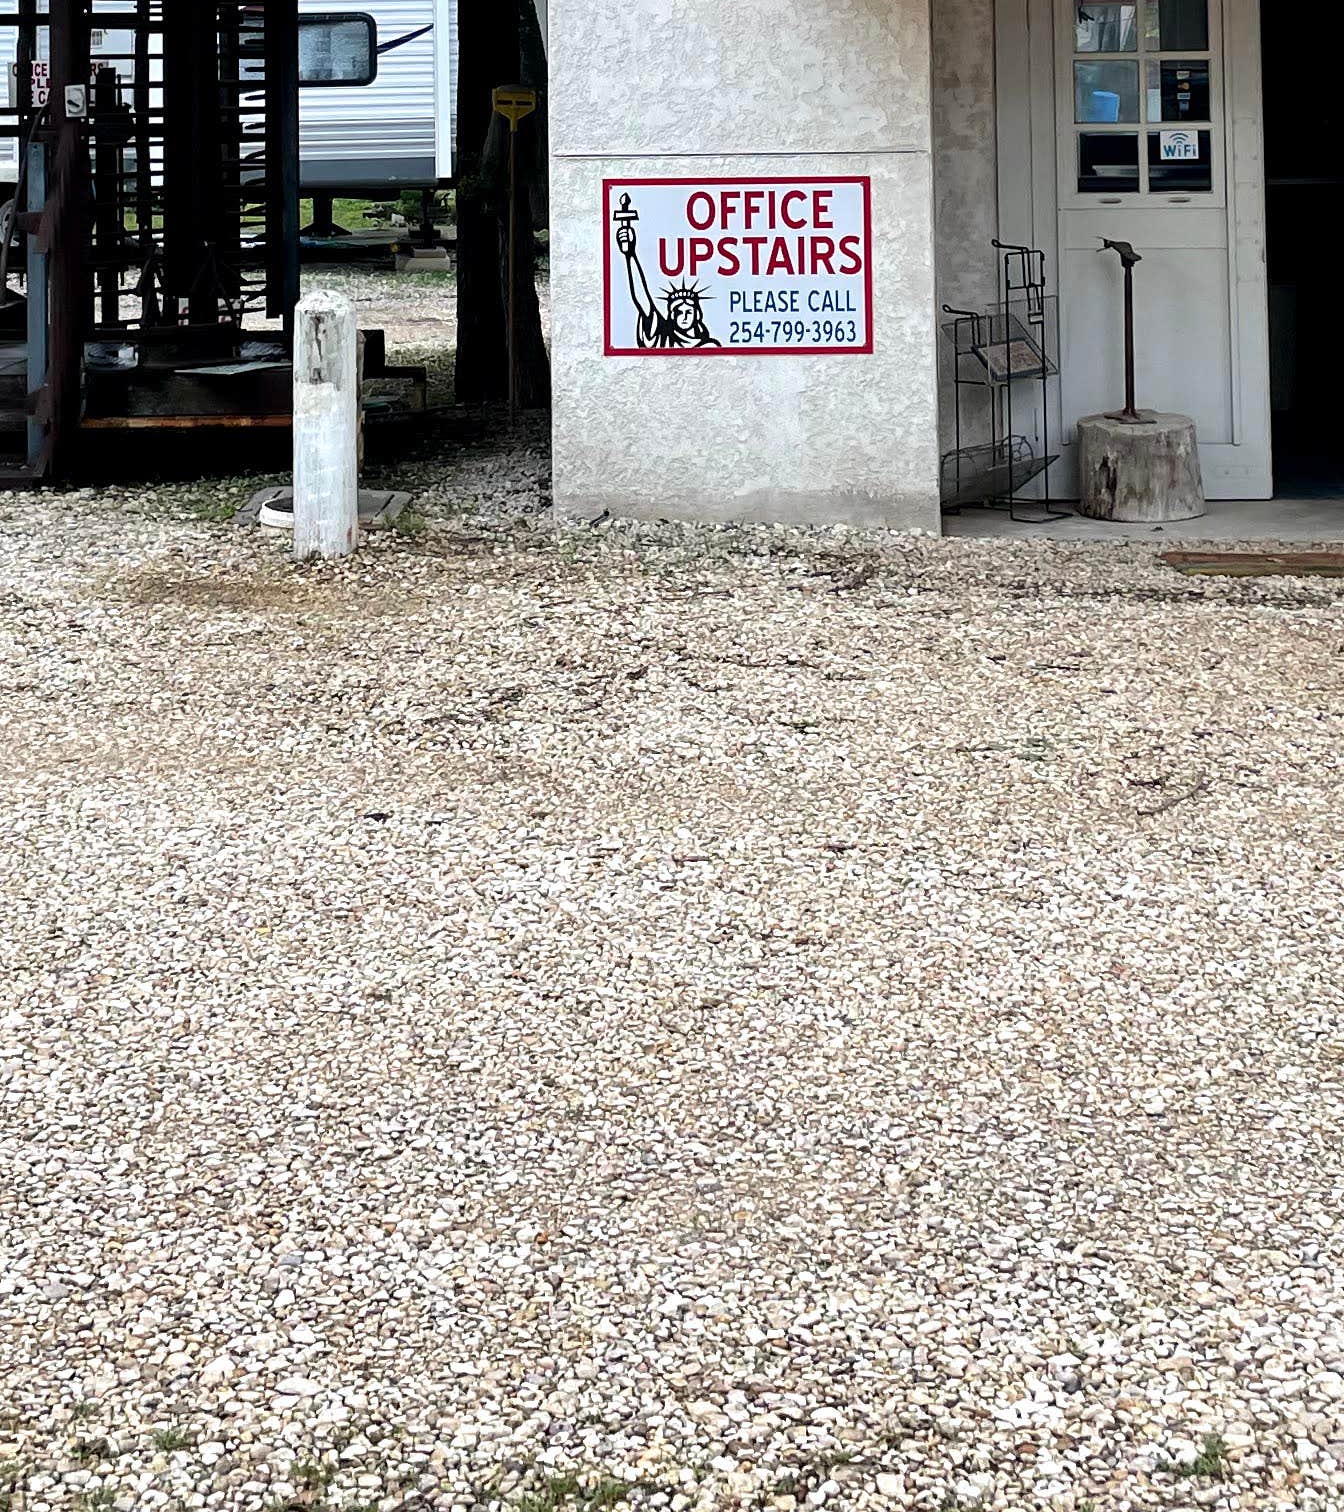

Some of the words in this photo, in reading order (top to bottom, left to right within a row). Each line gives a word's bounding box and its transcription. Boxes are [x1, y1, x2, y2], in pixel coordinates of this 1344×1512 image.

[1163, 144, 1197, 157] WiFi
[686, 189, 834, 231] OFFICE
[658, 235, 863, 277] UPSTAIRS
[729, 289, 800, 313] PLEASE
[807, 289, 857, 312] CALL
[729, 320, 857, 344] 254-799-3963
